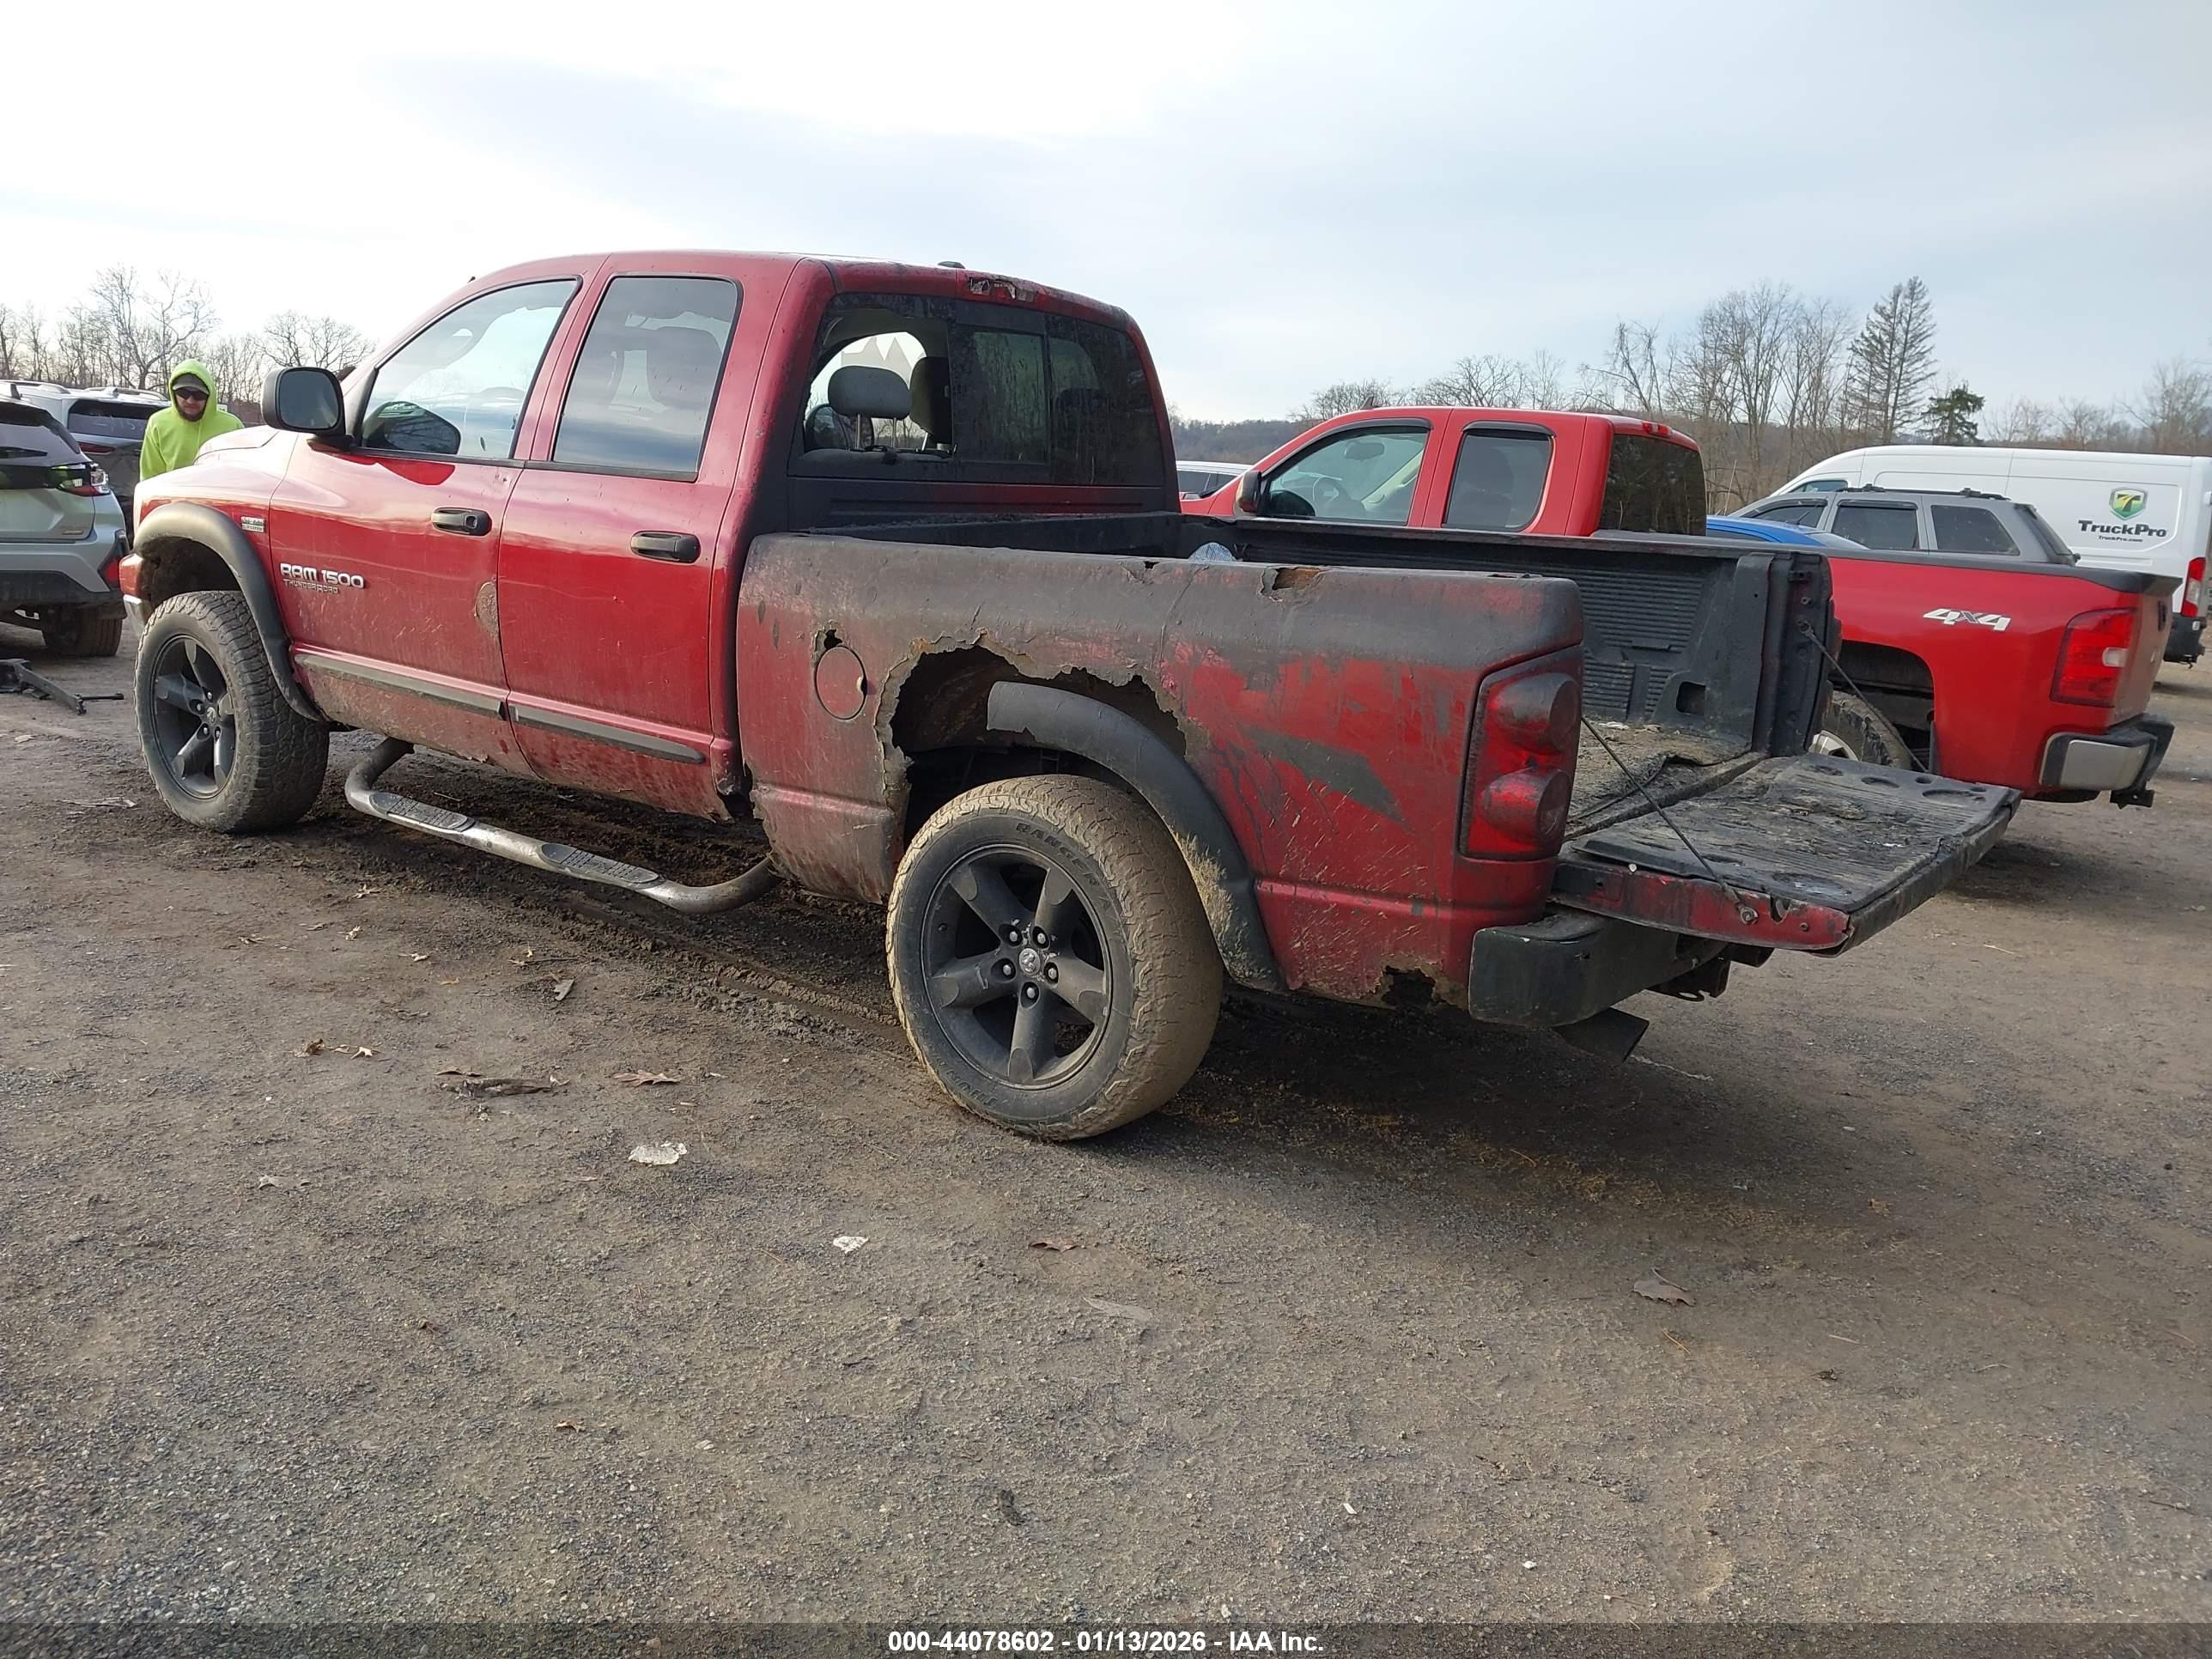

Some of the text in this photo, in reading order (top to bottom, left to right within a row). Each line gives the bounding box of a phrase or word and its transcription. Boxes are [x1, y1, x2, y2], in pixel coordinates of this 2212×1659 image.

[2078, 520, 2167, 538] TruckPro
[280, 562, 364, 589] RAM 1500
[1015, 822, 1101, 888] RANGER
